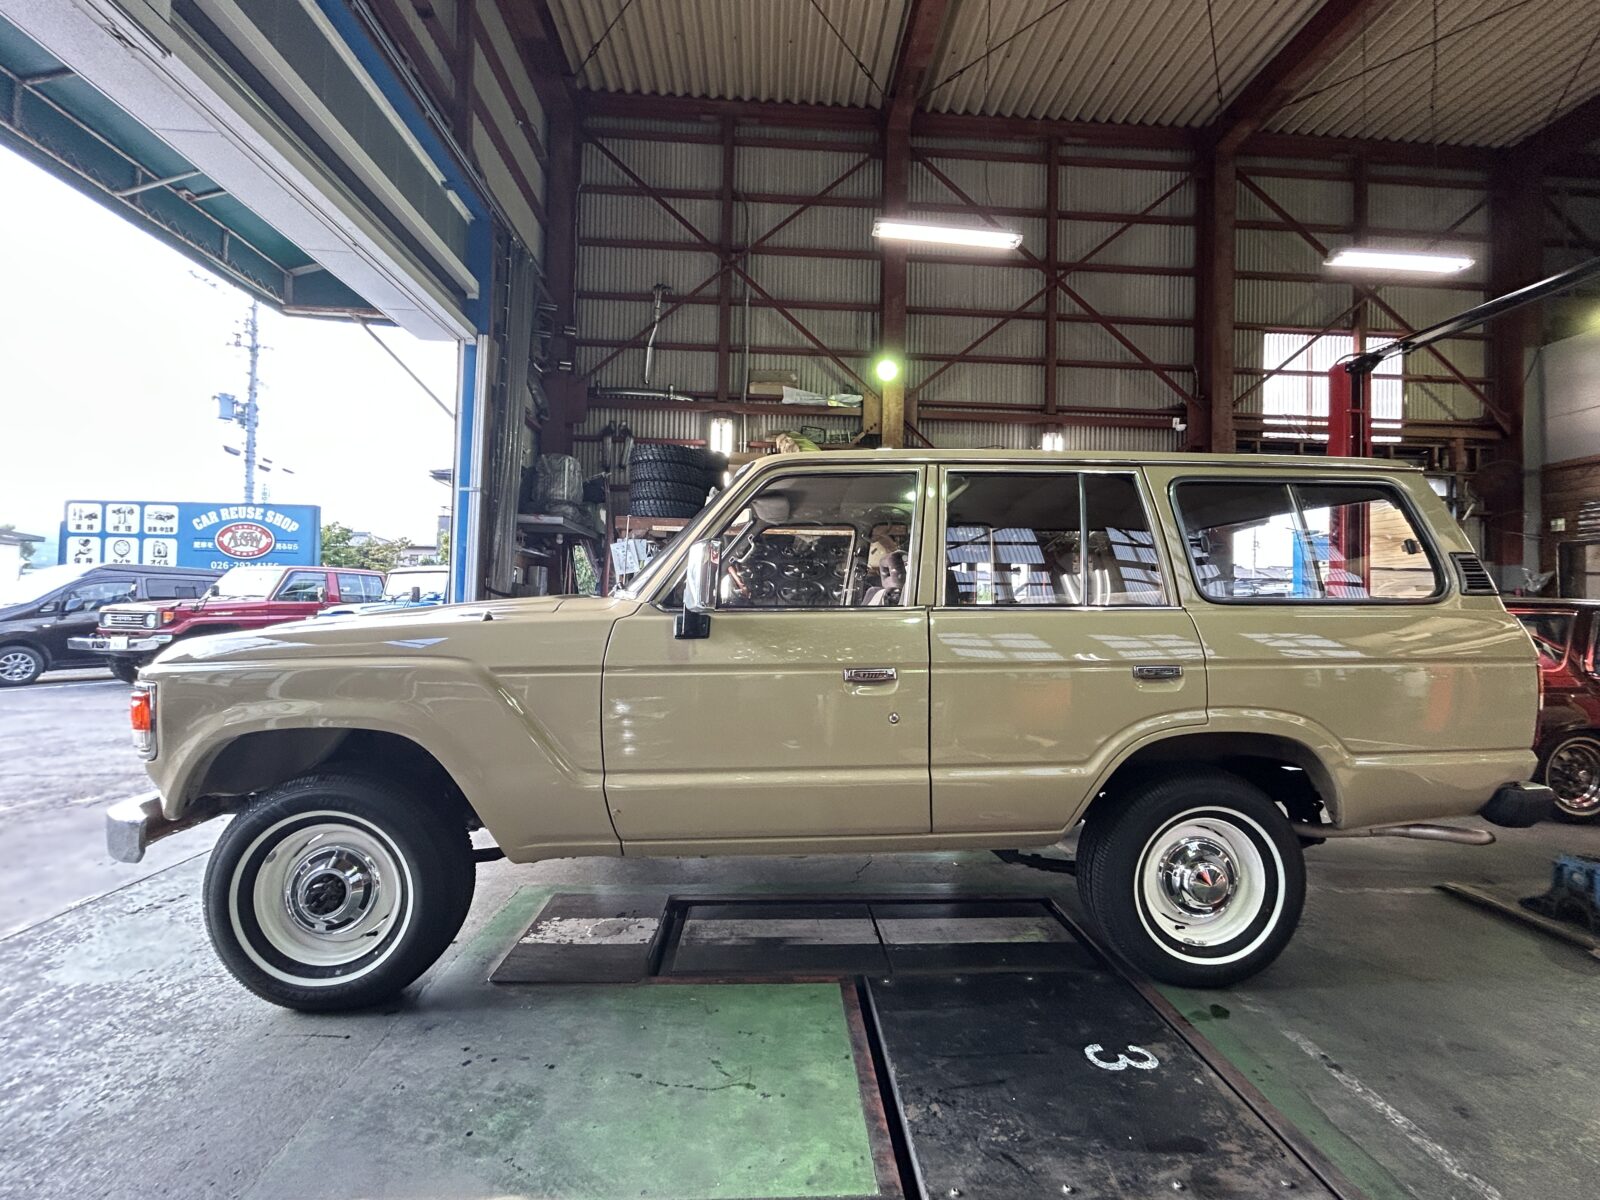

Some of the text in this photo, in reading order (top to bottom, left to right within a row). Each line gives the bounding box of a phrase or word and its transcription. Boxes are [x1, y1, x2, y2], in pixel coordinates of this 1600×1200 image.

[192, 506, 300, 532] CAR REUSE SHOP
[1084, 1043, 1160, 1071] 3
